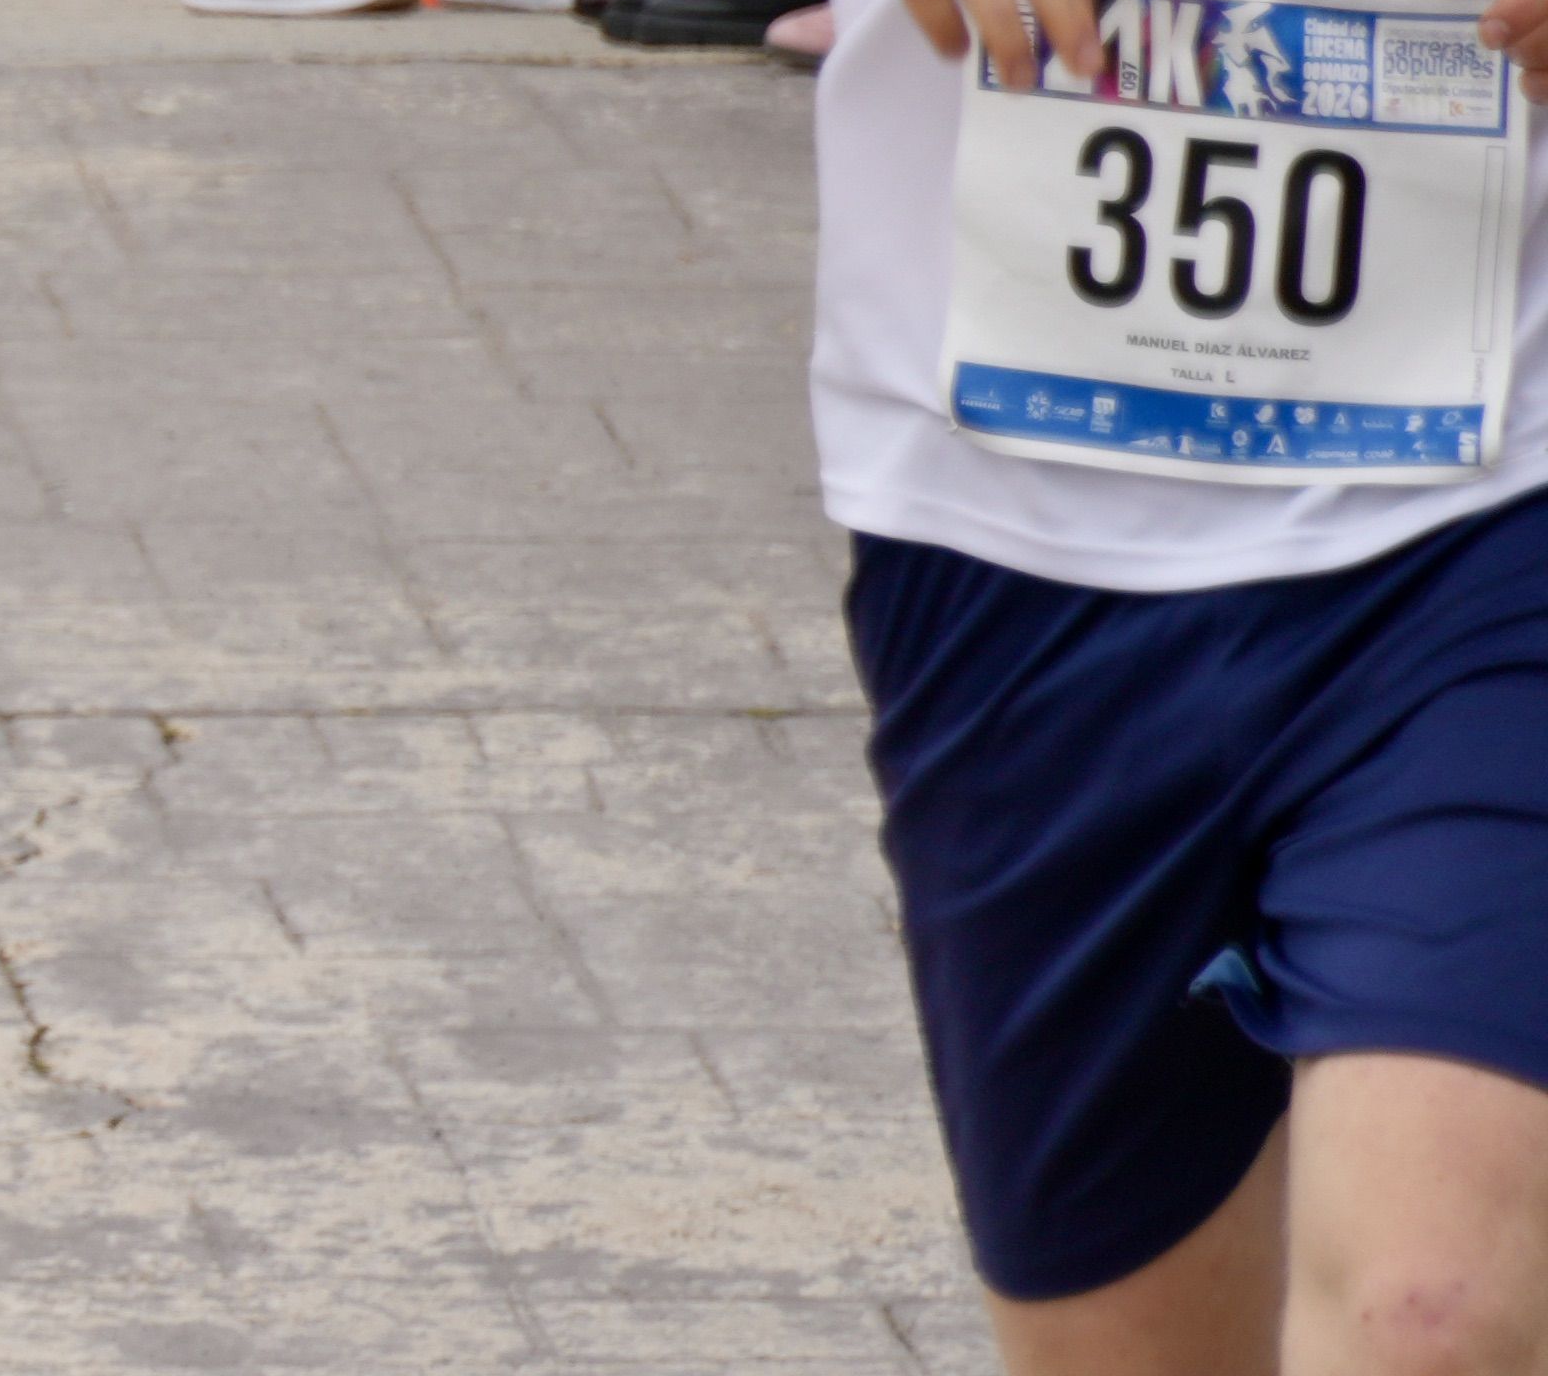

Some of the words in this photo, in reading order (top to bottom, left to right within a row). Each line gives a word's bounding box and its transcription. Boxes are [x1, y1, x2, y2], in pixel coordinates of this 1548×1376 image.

[1383, 39, 1477, 60] carreras
[1383, 54, 1494, 79] populares
[1301, 82, 1368, 119] 2026
[1066, 125, 1366, 327] 350
[1126, 334, 1189, 353] MANUEL
[1171, 368, 1212, 382] TALLA
[1226, 370, 1235, 383] L
